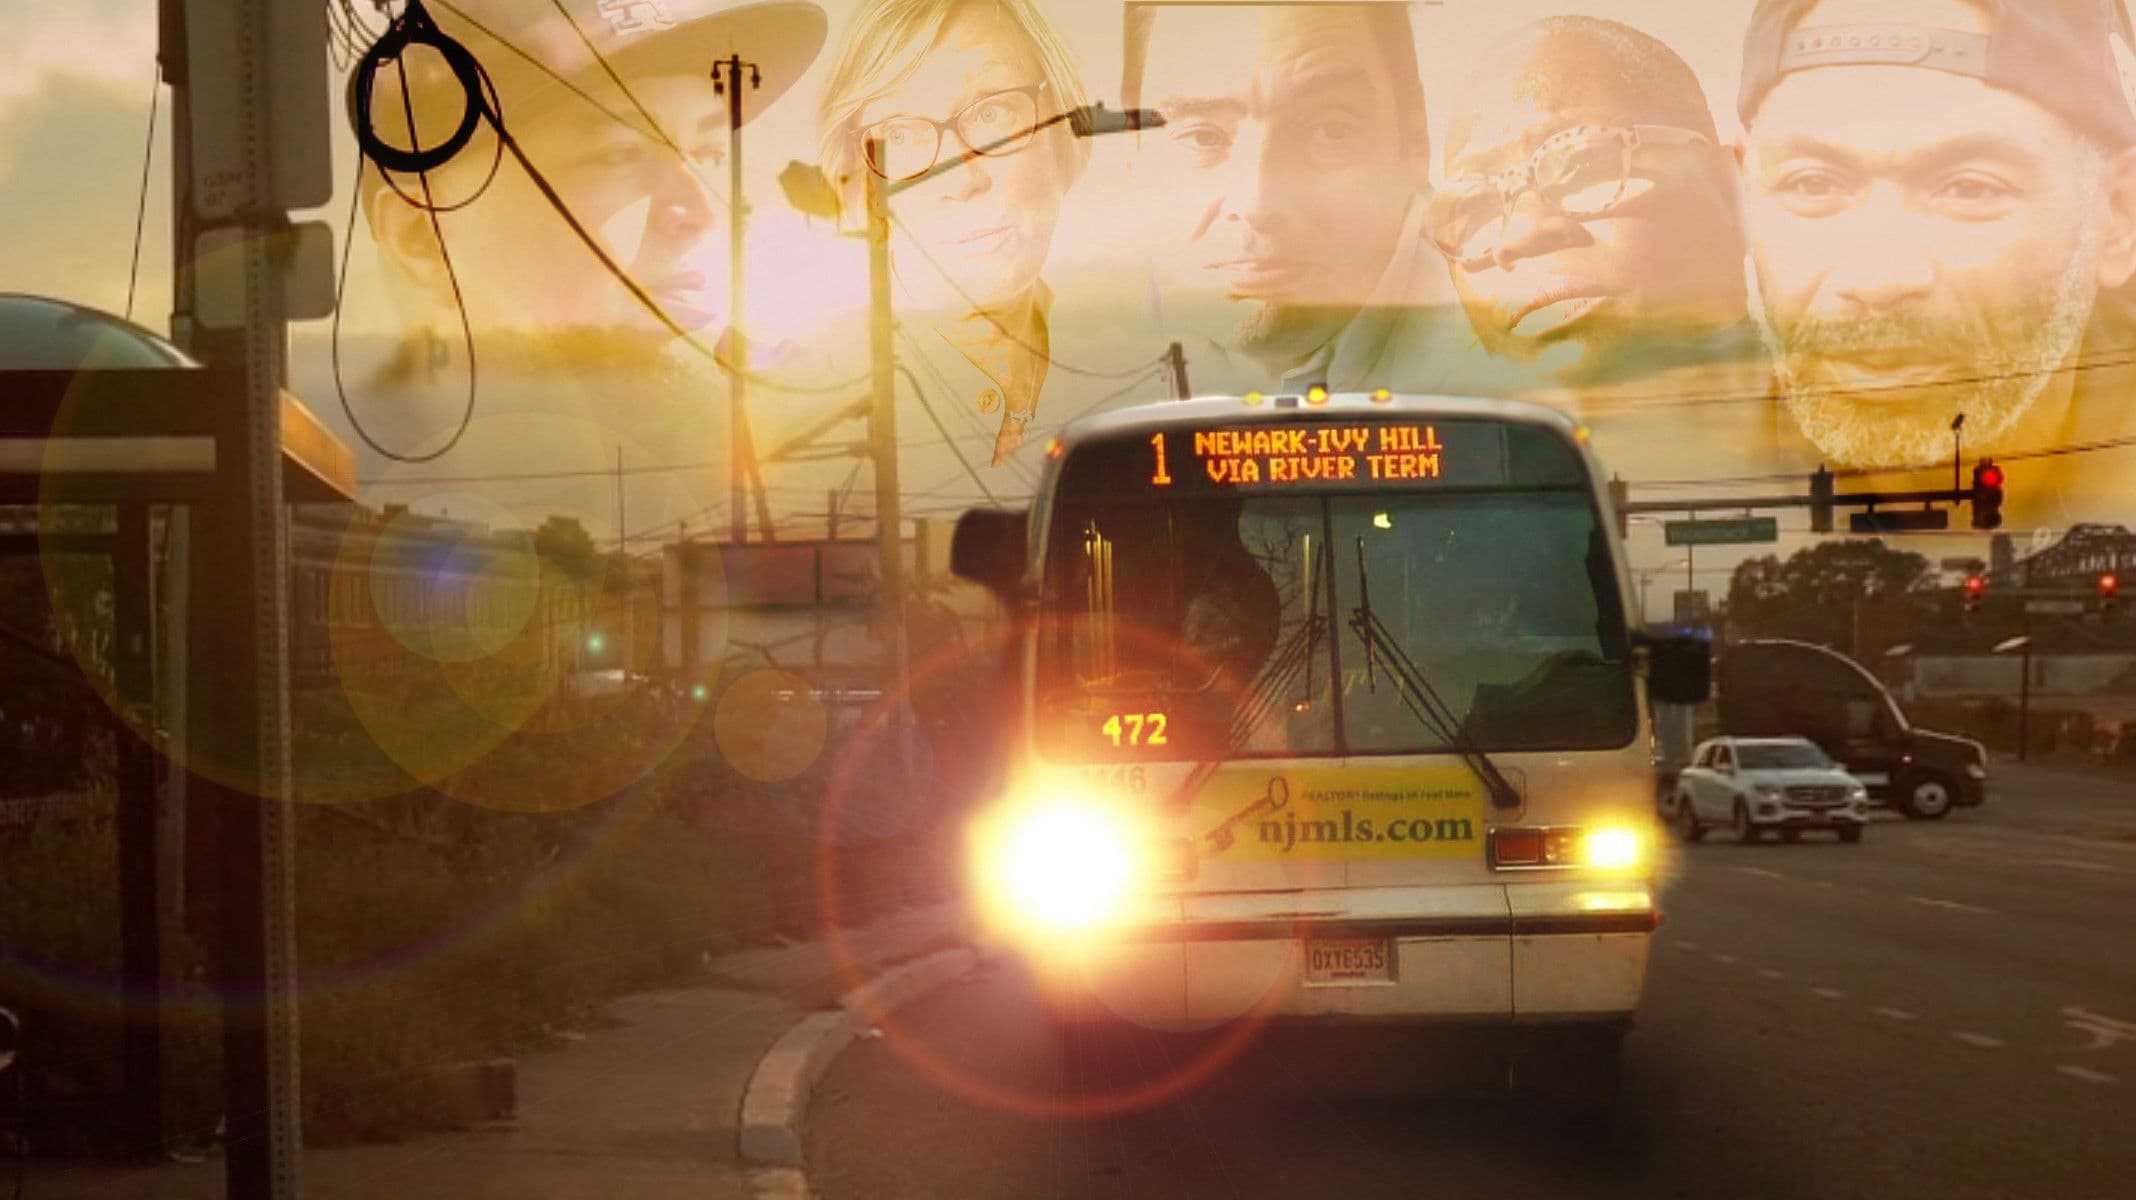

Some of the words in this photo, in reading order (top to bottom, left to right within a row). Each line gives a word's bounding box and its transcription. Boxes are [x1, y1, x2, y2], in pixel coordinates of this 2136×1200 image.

[1194, 428, 1369, 455] NEWARK-IVY
[1379, 426, 1442, 450] HILL
[1151, 432, 1171, 485] 1
[1206, 457, 1260, 482] VIA
[1269, 455, 1355, 481] RIVER
[1366, 453, 1439, 479] TERM
[1102, 713, 1167, 747] 472
[1258, 809, 1473, 853] njmls.com
